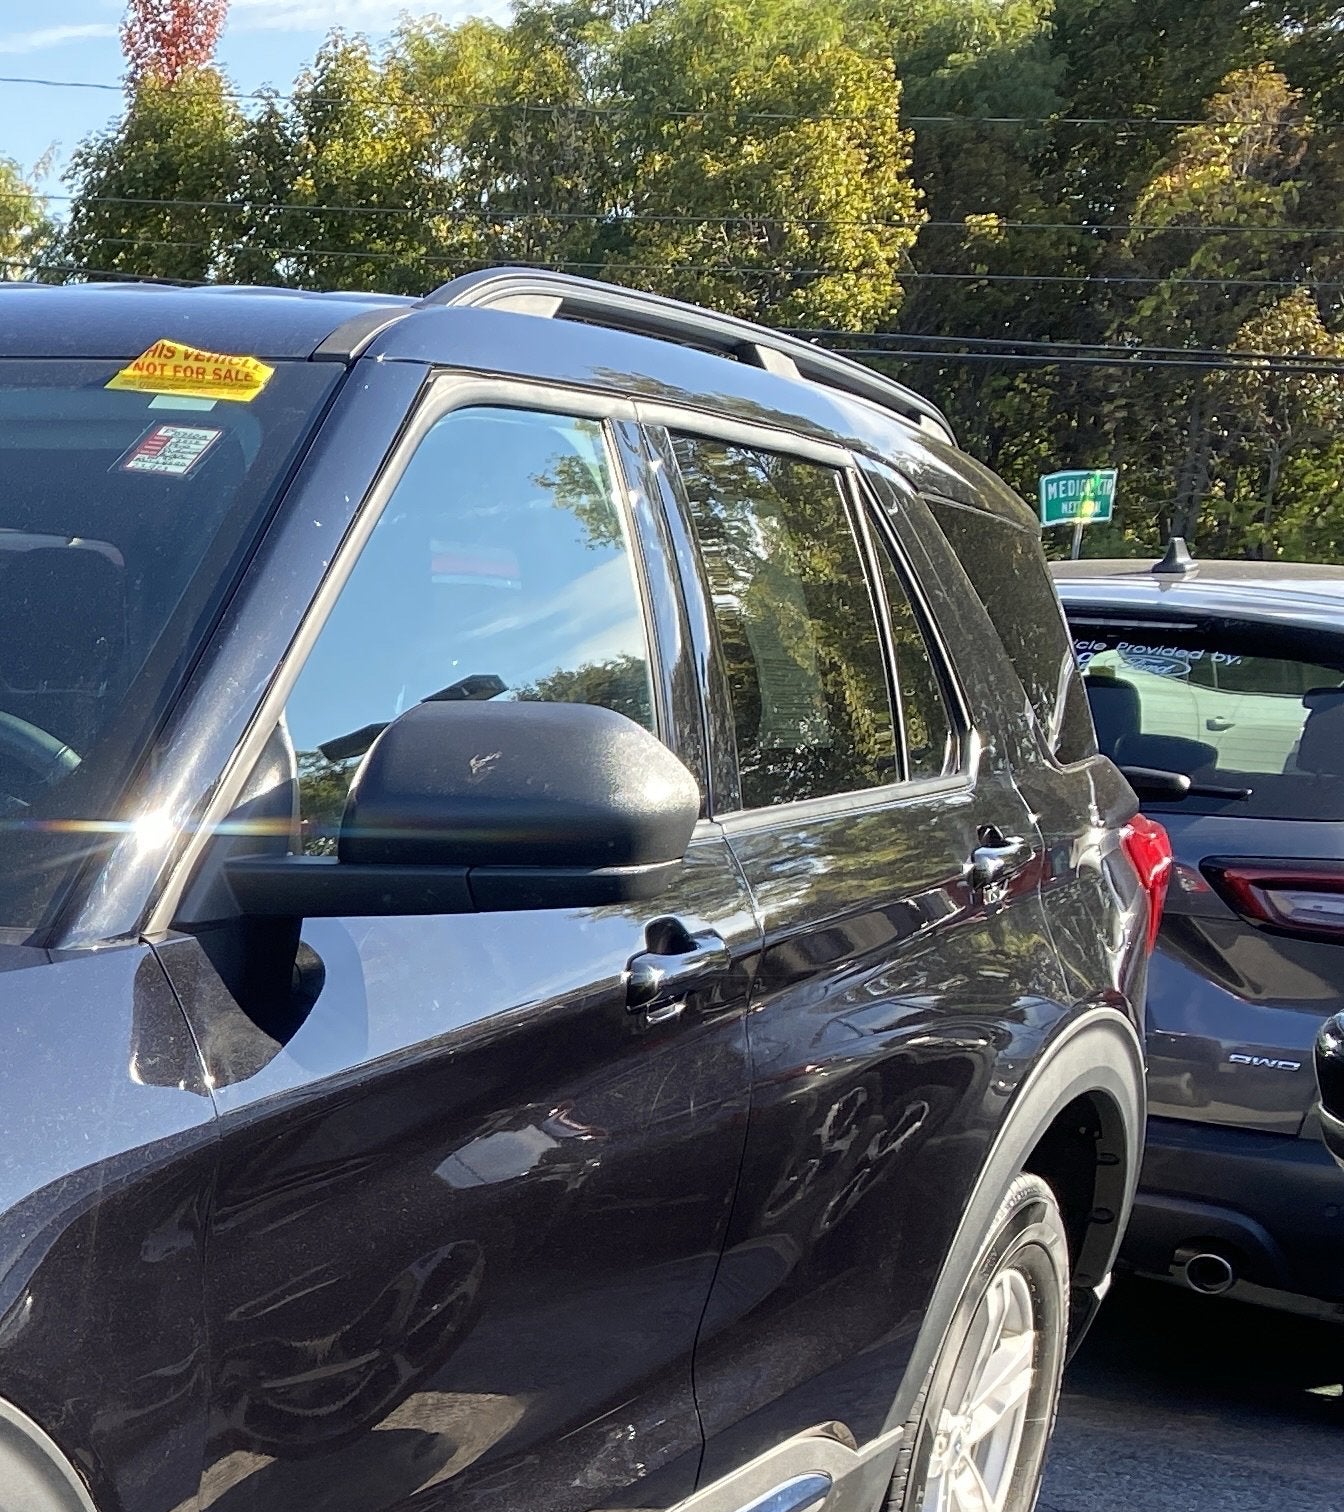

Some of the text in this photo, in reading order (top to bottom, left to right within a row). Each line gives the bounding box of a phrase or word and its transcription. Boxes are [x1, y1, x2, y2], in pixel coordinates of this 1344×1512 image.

[133, 362, 254, 383] NOT FOR SALE
[1116, 641, 1205, 659] Provided
